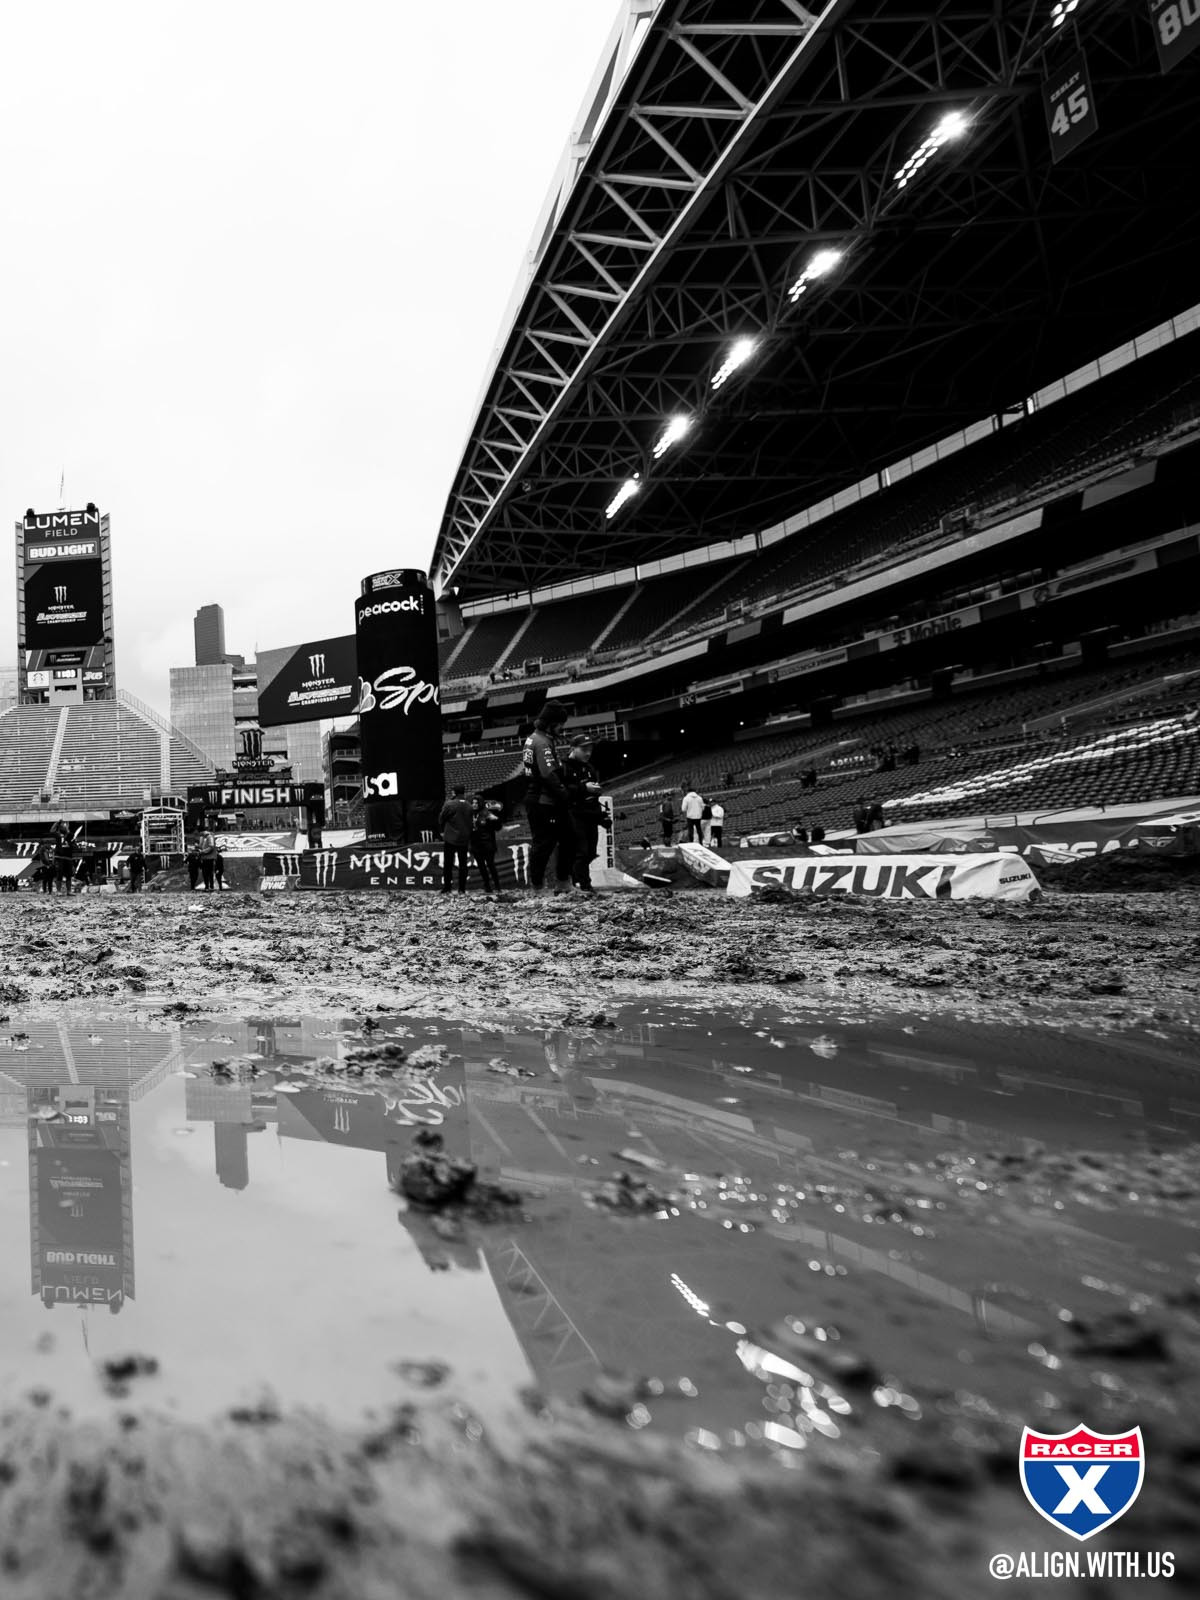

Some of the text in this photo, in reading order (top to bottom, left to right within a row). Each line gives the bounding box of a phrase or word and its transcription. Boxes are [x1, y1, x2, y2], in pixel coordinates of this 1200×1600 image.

[1051, 84, 1089, 136] 45
[24, 511, 99, 530] LUMEN
[45, 528, 78, 538] FIELD
[29, 543, 95, 558] BUD LIGHT
[358, 595, 420, 625] peacock
[910, 614, 962, 643] Mobile
[301, 677, 336, 688] MONSTER
[232, 759, 275, 768] MONSTER
[221, 787, 291, 805] FINISH
[751, 865, 955, 900] SUZUKI
[998, 872, 1031, 884] SUZUKI
